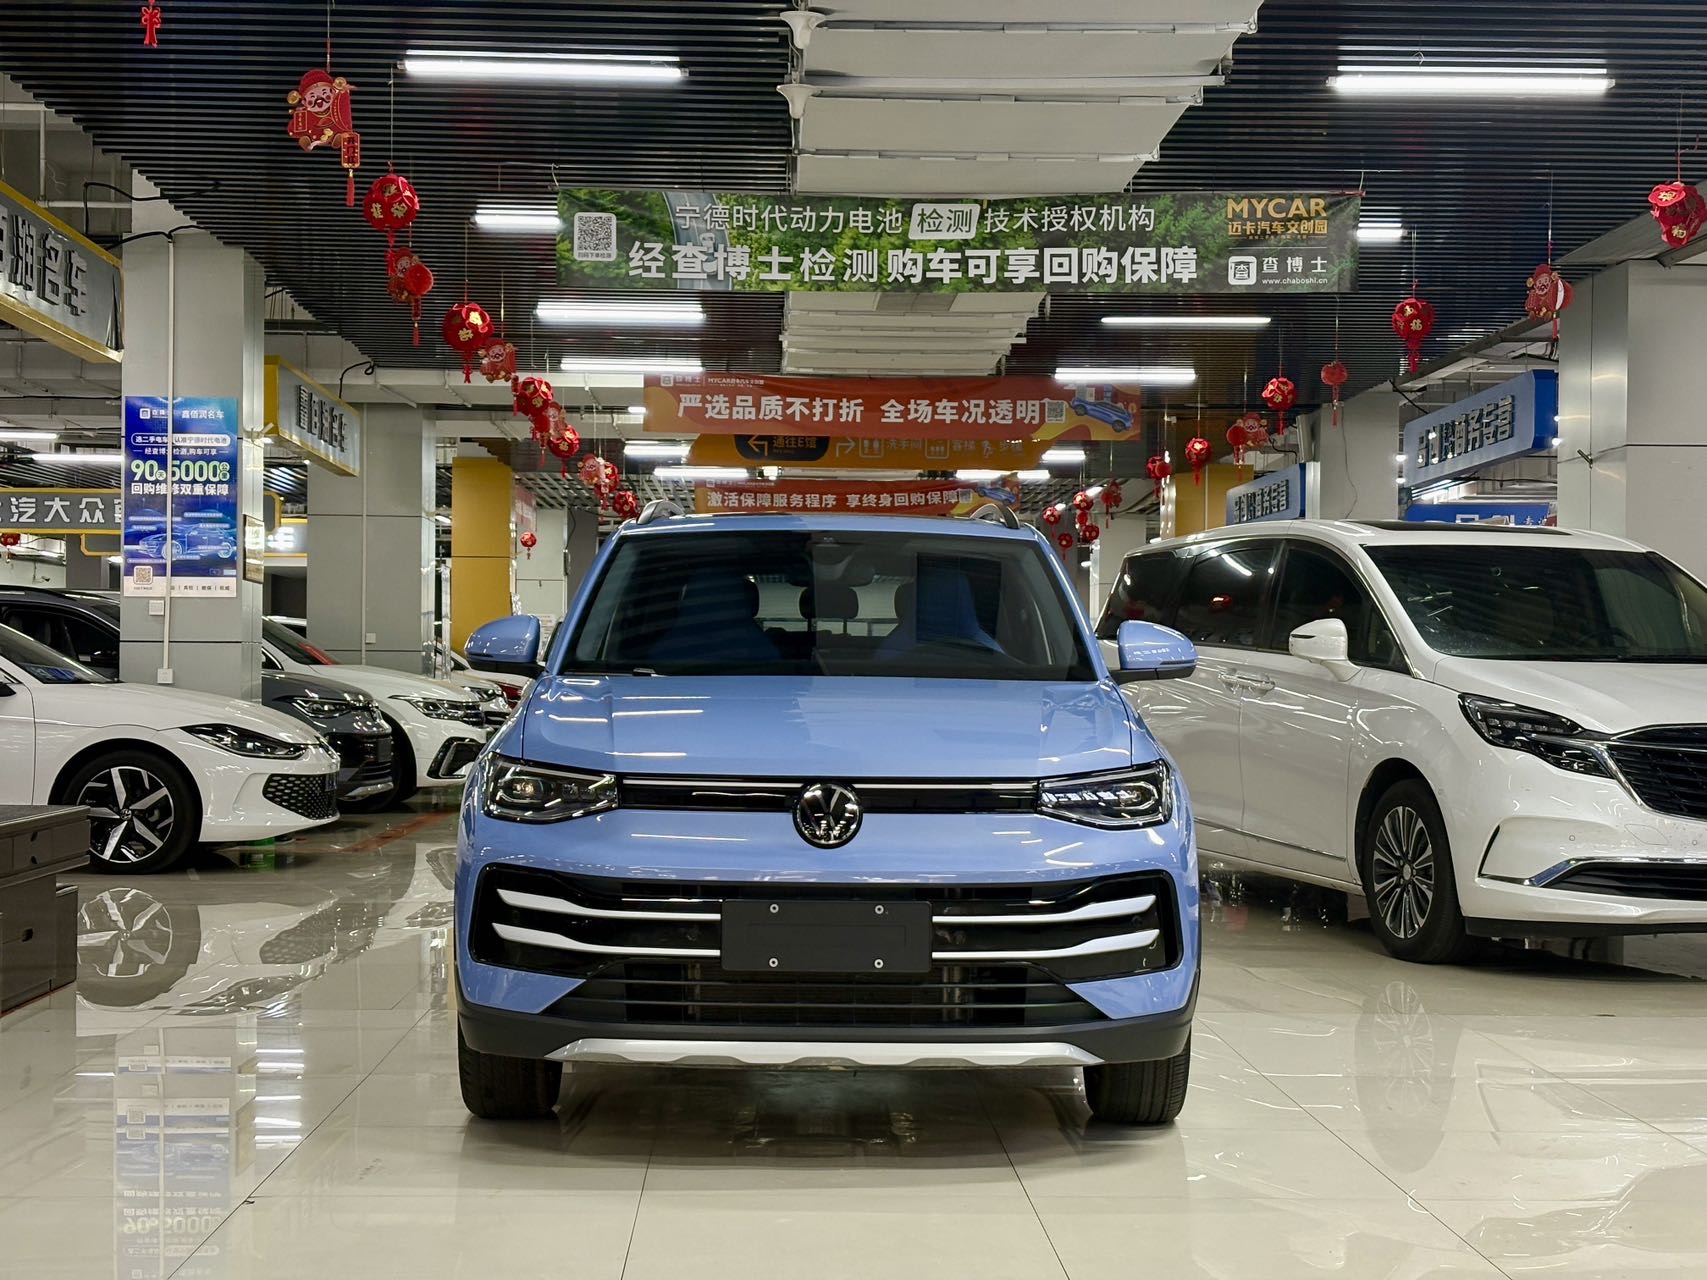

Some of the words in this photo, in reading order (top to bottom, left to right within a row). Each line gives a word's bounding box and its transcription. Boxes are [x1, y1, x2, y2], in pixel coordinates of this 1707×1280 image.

[675, 204, 1155, 234] 宁德时代动力电池检测技术授权机构
[1227, 198, 1328, 219] MYCAR
[1228, 220, 1328, 235] 迈卡汽车文创园
[629, 240, 1198, 285] 经查博士检测购车可享回购保障
[1261, 256, 1328, 273] 查博士
[678, 394, 865, 423] 严选品质不打折
[880, 399, 1040, 424] 全场车况透明
[0, 496, 121, 523] 汽大众
[707, 491, 837, 508] 激活保障服务程序
[847, 489, 960, 507] 享终身回购保障
